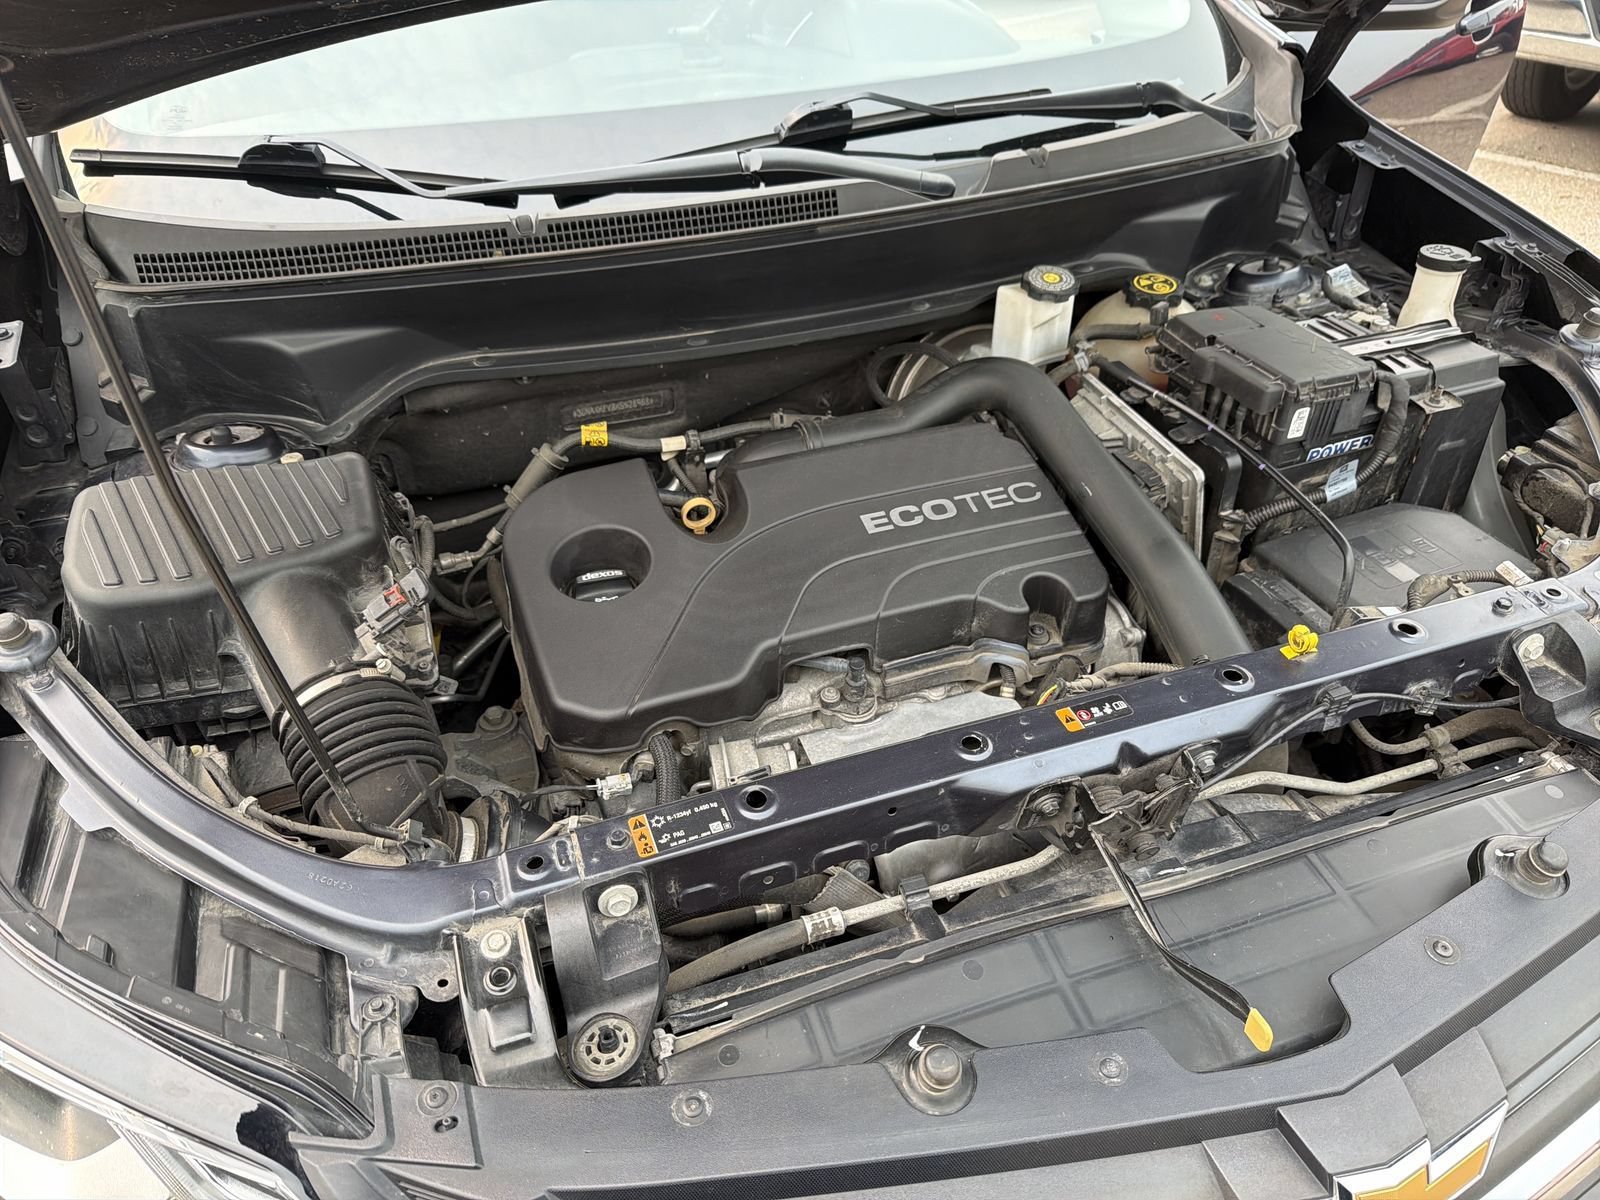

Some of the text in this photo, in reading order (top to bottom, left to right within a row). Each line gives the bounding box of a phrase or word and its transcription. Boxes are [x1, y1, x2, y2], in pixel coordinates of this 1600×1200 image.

[1307, 435, 1374, 462] POWER
[859, 481, 1042, 535] ECOTEC
[581, 570, 624, 581] dexos
[673, 830, 685, 838] PAG
